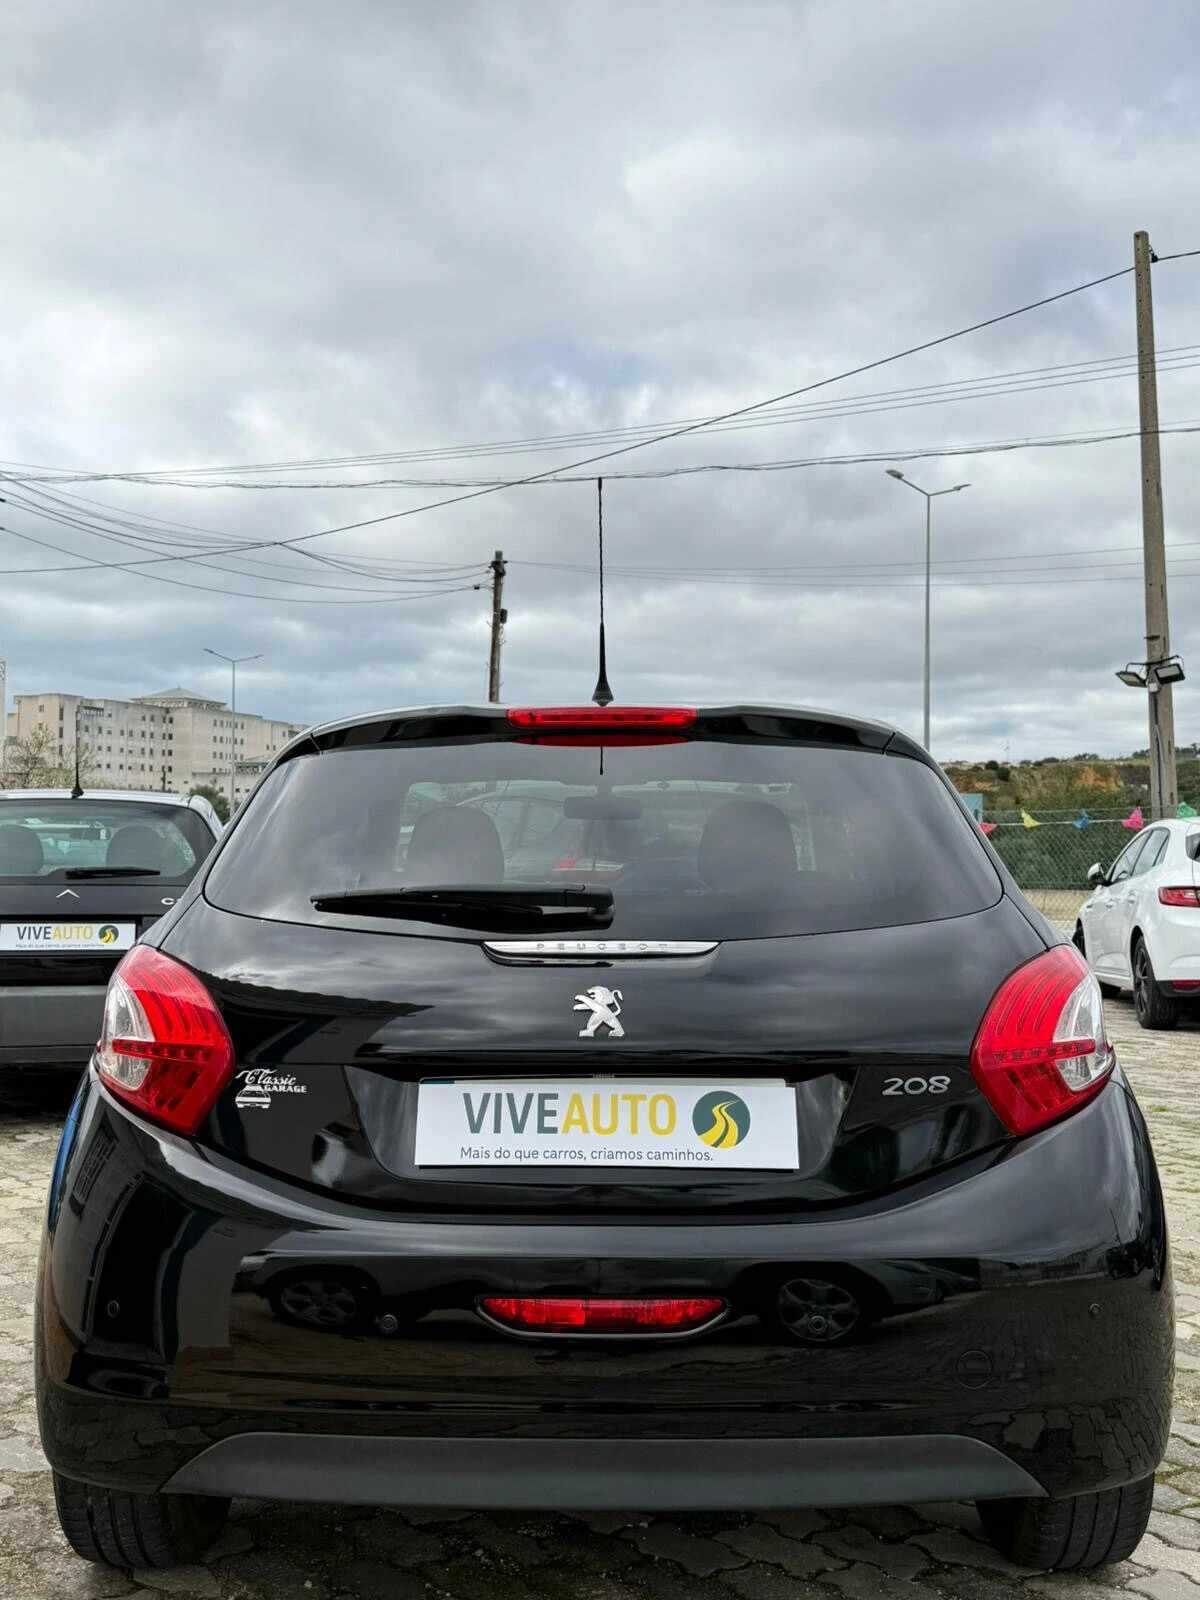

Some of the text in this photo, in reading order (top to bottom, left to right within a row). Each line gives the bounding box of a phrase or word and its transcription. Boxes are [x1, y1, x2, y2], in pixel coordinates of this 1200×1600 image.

[17, 926, 94, 940] VIVEAUTO
[235, 1069, 297, 1086] Classic
[882, 1076, 951, 1095] 208
[263, 1085, 307, 1093] GARAGE
[462, 1091, 677, 1136] VIVEAUTO
[460, 1146, 713, 1162] Mais do que carros, criamos caminhos.
